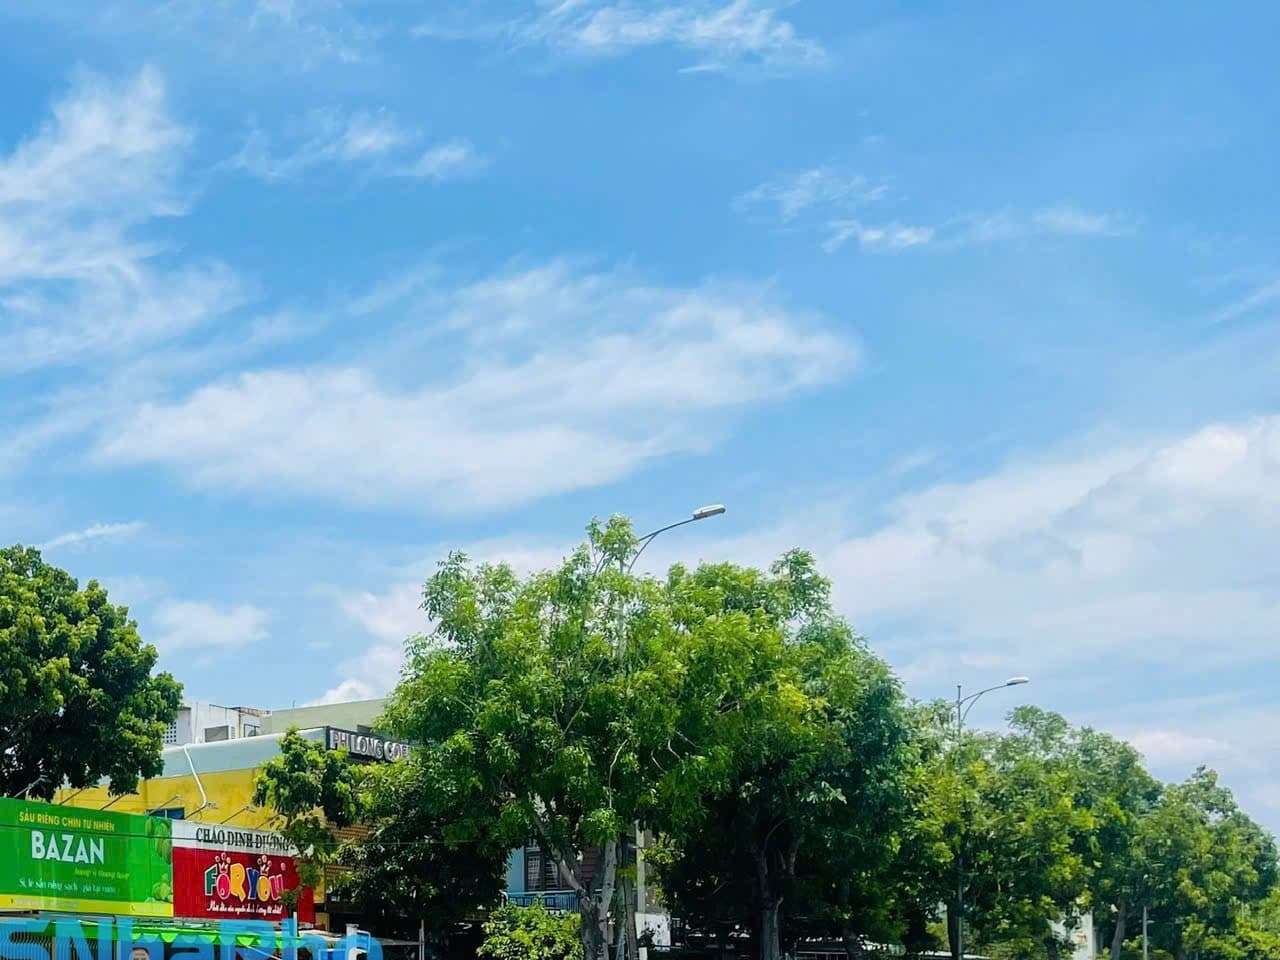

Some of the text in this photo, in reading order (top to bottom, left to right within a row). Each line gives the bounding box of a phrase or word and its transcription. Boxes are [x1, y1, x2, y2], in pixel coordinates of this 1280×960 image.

[350, 734, 384, 760] LONG
[31, 830, 105, 865] BAZAN
[227, 831, 253, 848] DINH
